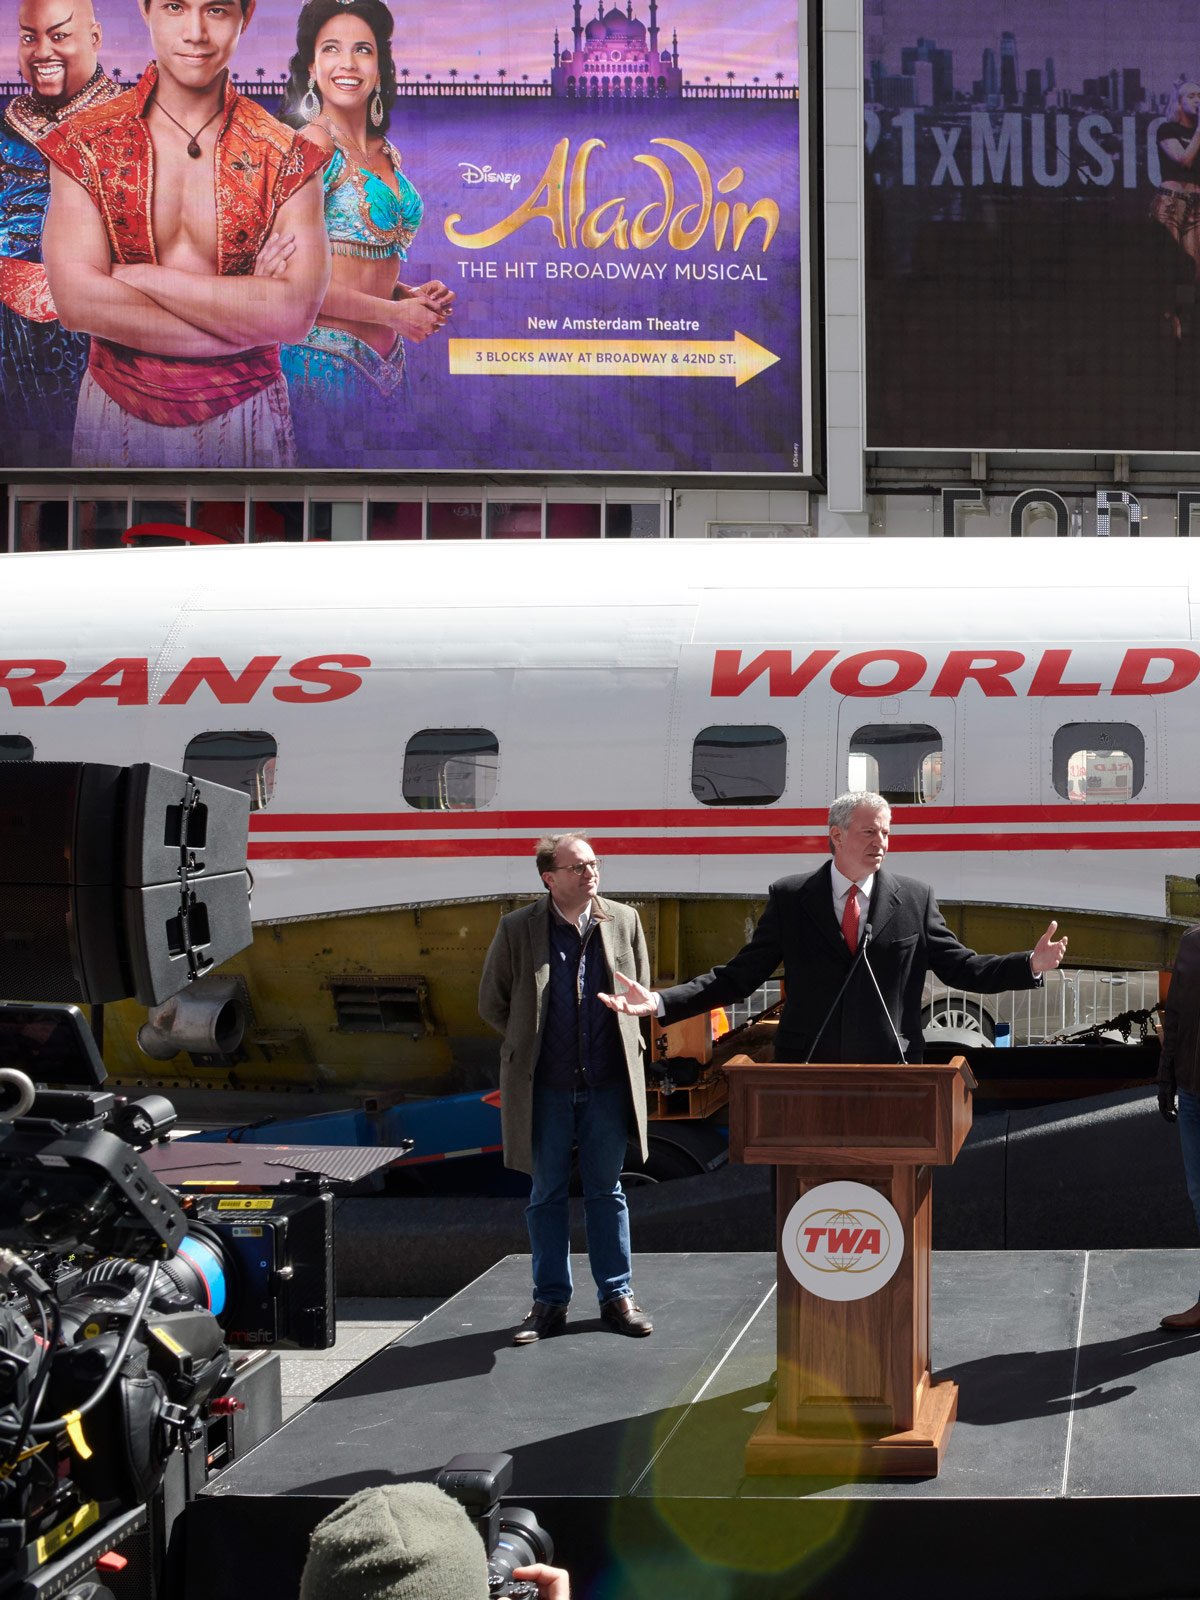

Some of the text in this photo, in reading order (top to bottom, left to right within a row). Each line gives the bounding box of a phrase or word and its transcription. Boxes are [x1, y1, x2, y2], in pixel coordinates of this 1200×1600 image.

[444, 137, 780, 252] Aladdin
[457, 260, 769, 282] THE HIT BROADWAY MUSICAL
[527, 316, 700, 332] New Amsterdam Theatre
[475, 351, 737, 365] 3 BLOCKS AWAY AT BROADWAY & 42ND ST.
[0, 654, 371, 706] RANS
[804, 1227, 880, 1255] TWA
